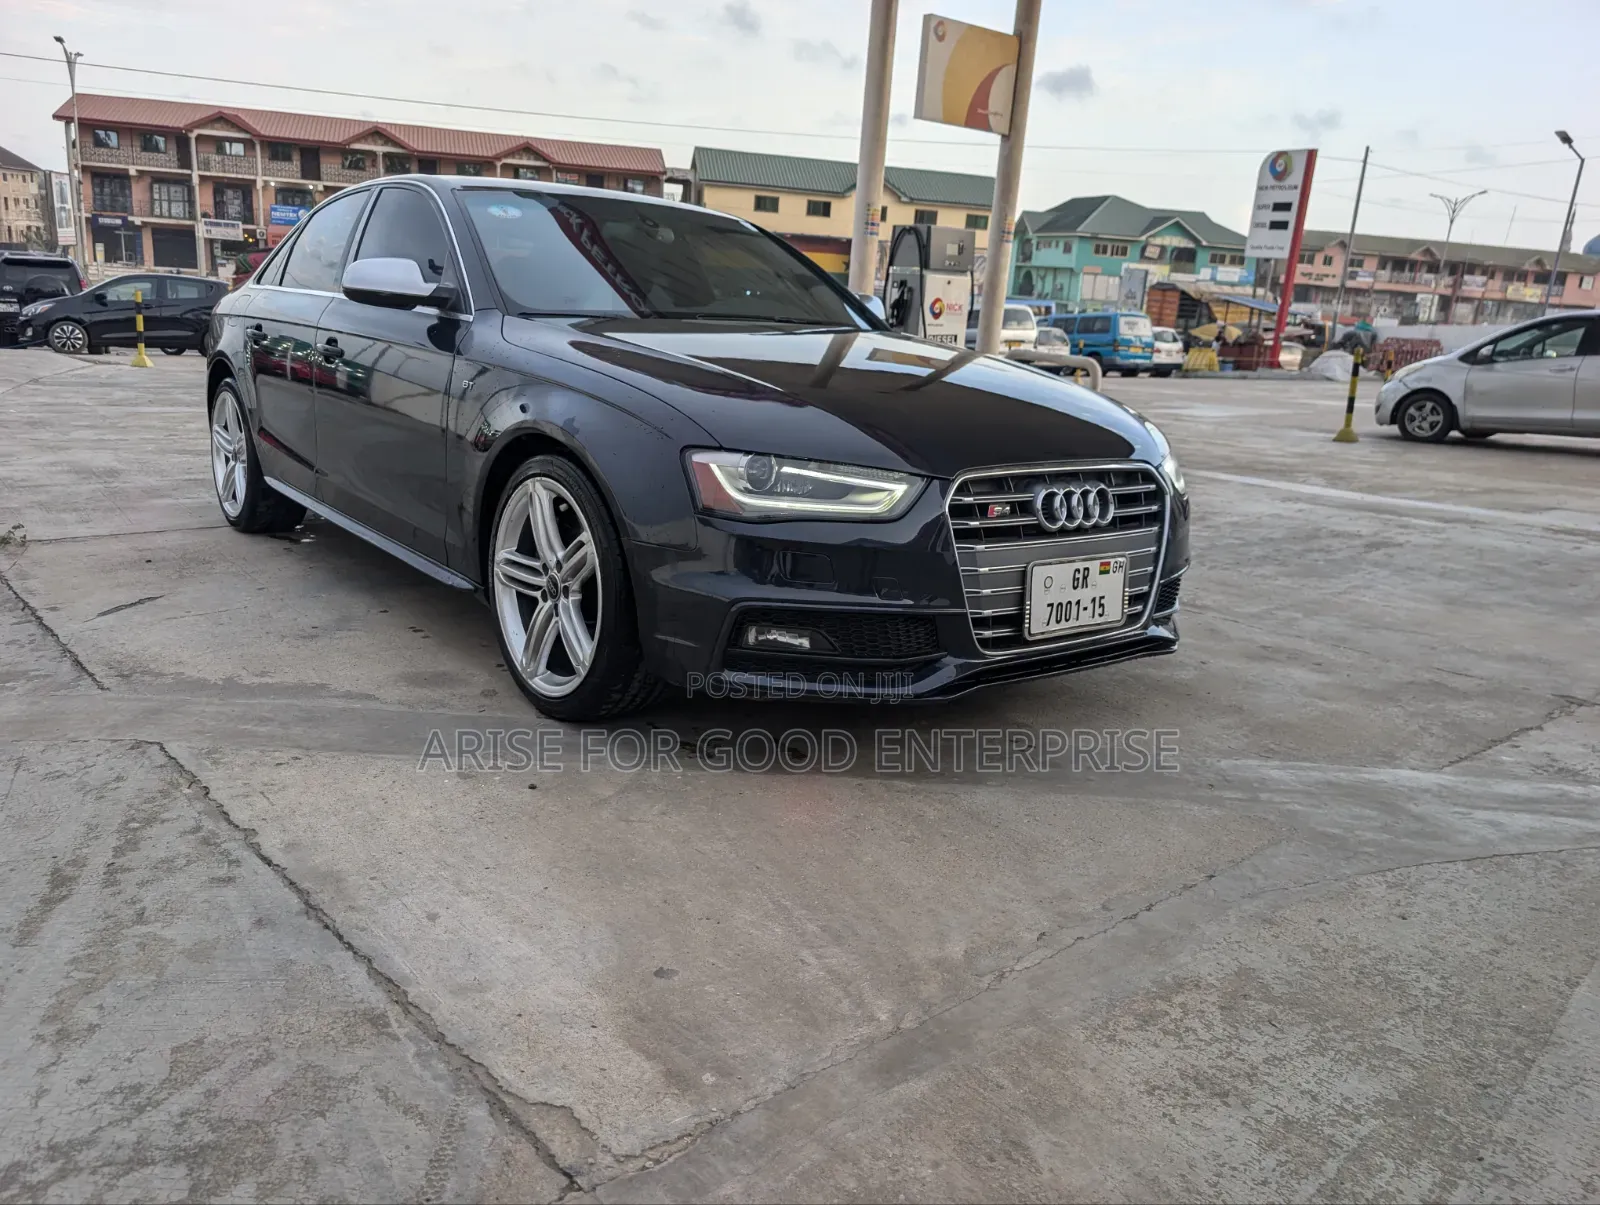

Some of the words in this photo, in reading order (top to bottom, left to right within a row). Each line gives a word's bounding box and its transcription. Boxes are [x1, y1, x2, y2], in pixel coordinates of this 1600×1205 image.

[1072, 567, 1090, 590] GR
[1112, 561, 1124, 574] GH
[1046, 596, 1105, 626] 7001-15
